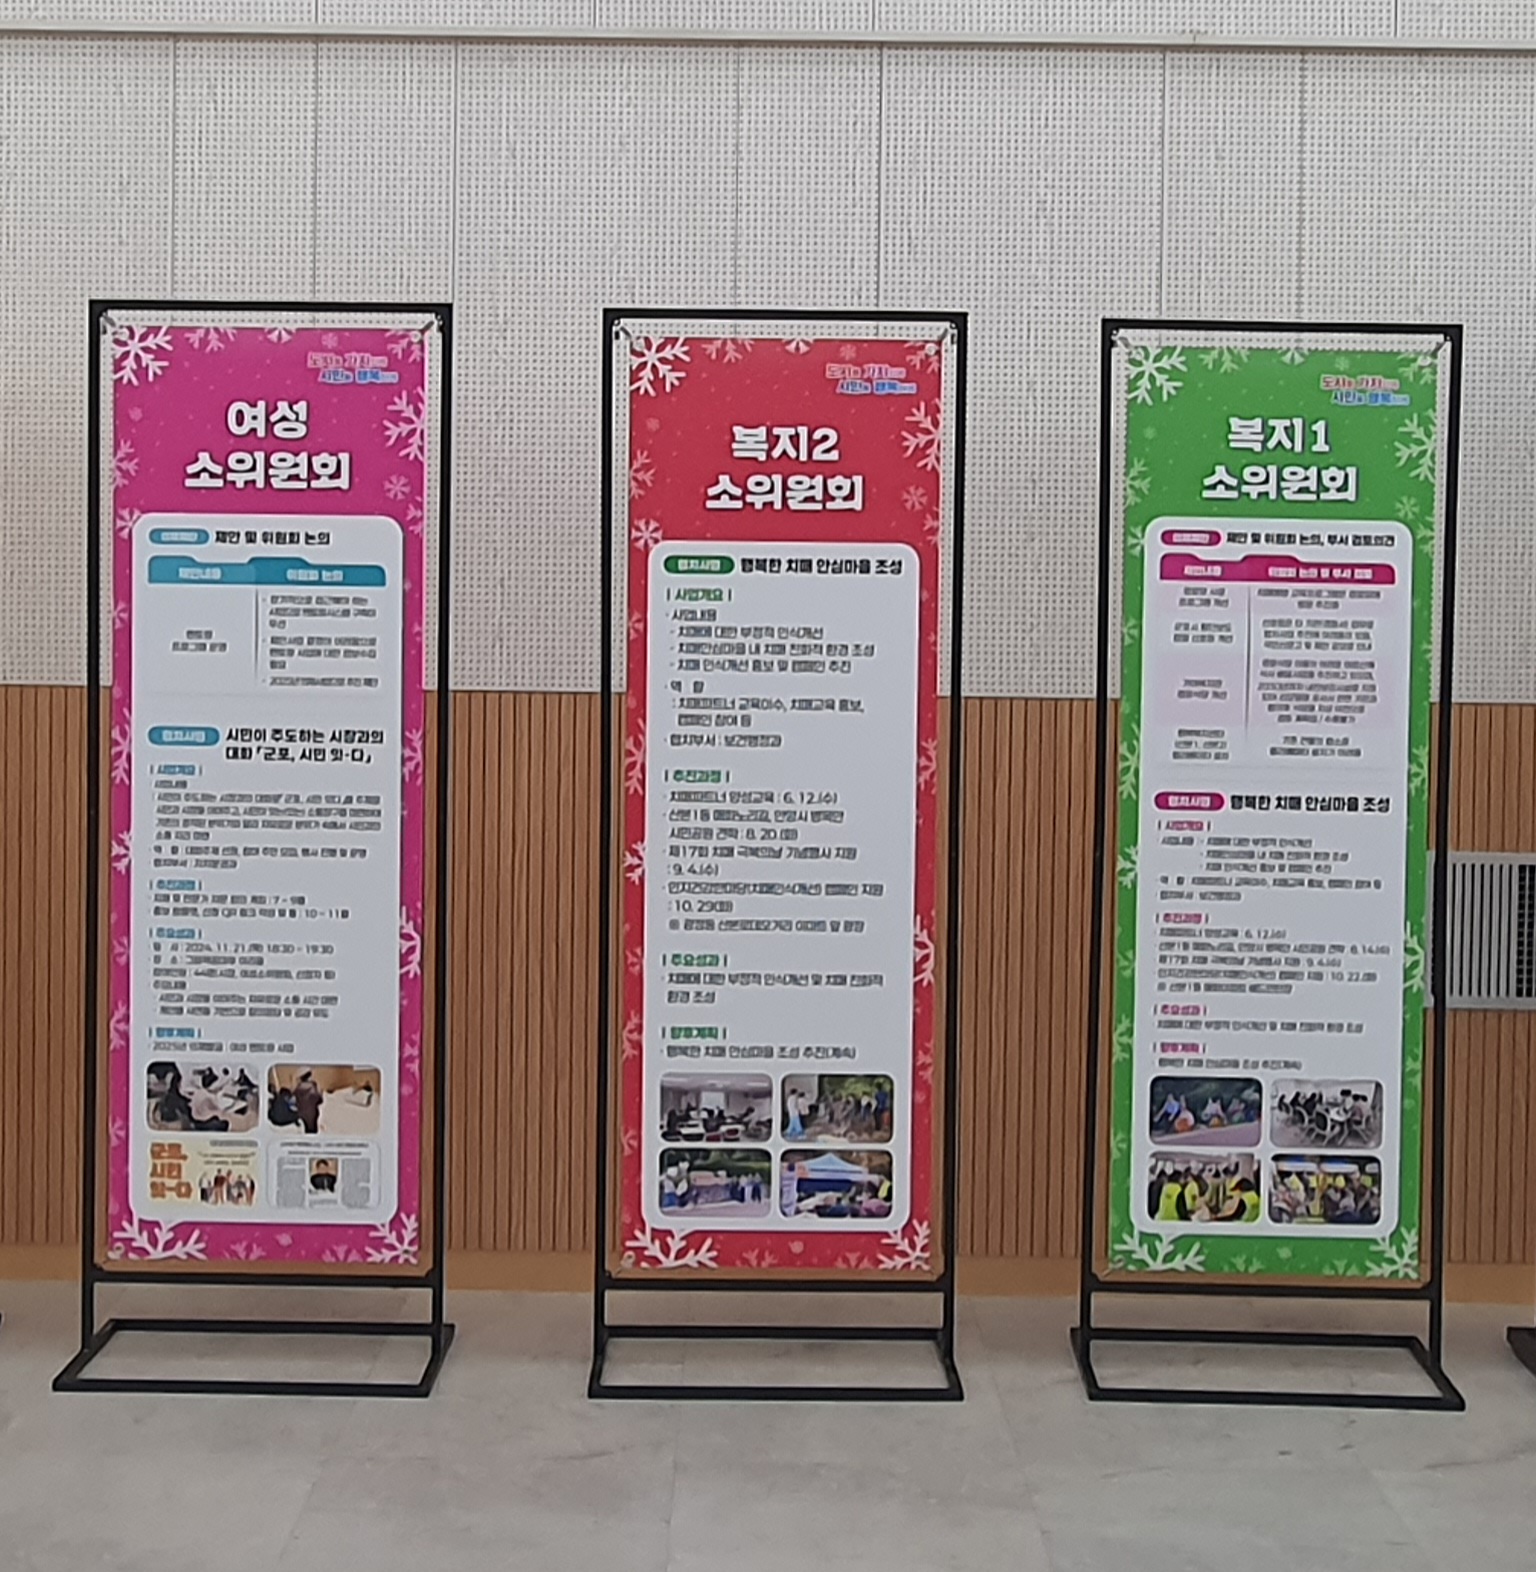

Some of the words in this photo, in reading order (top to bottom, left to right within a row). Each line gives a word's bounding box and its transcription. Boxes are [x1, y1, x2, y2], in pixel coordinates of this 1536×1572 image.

[227, 400, 308, 439] 여성
[731, 426, 840, 461] 복지2
[184, 450, 350, 490] 소위원회
[1202, 465, 1357, 501] 소위원회
[705, 474, 864, 511] 소위원회
[225, 727, 267, 744] 시민이
[270, 728, 325, 744] 주도하는
[329, 728, 384, 745] 시장과의
[299, 747, 326, 763] 시민
